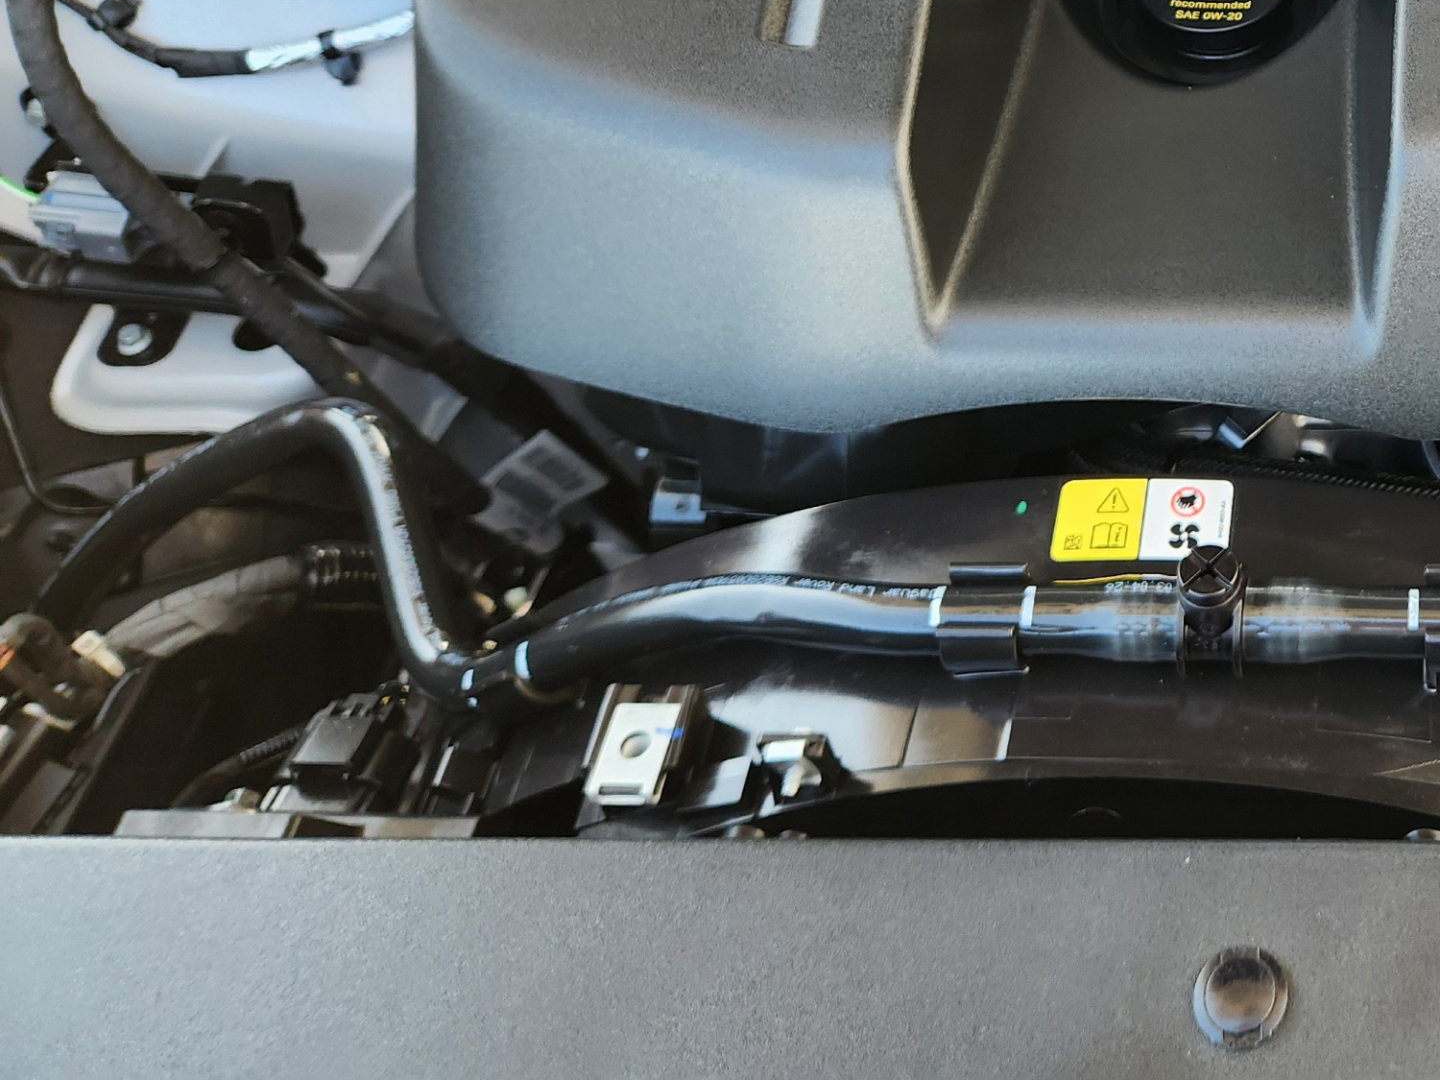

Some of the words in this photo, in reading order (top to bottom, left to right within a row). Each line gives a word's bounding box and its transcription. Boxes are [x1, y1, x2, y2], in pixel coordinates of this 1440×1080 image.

[1169, 0, 1252, 10] recommended
[1175, 9, 1201, 20] SAE
[1202, 10, 1244, 21] 0W-20
